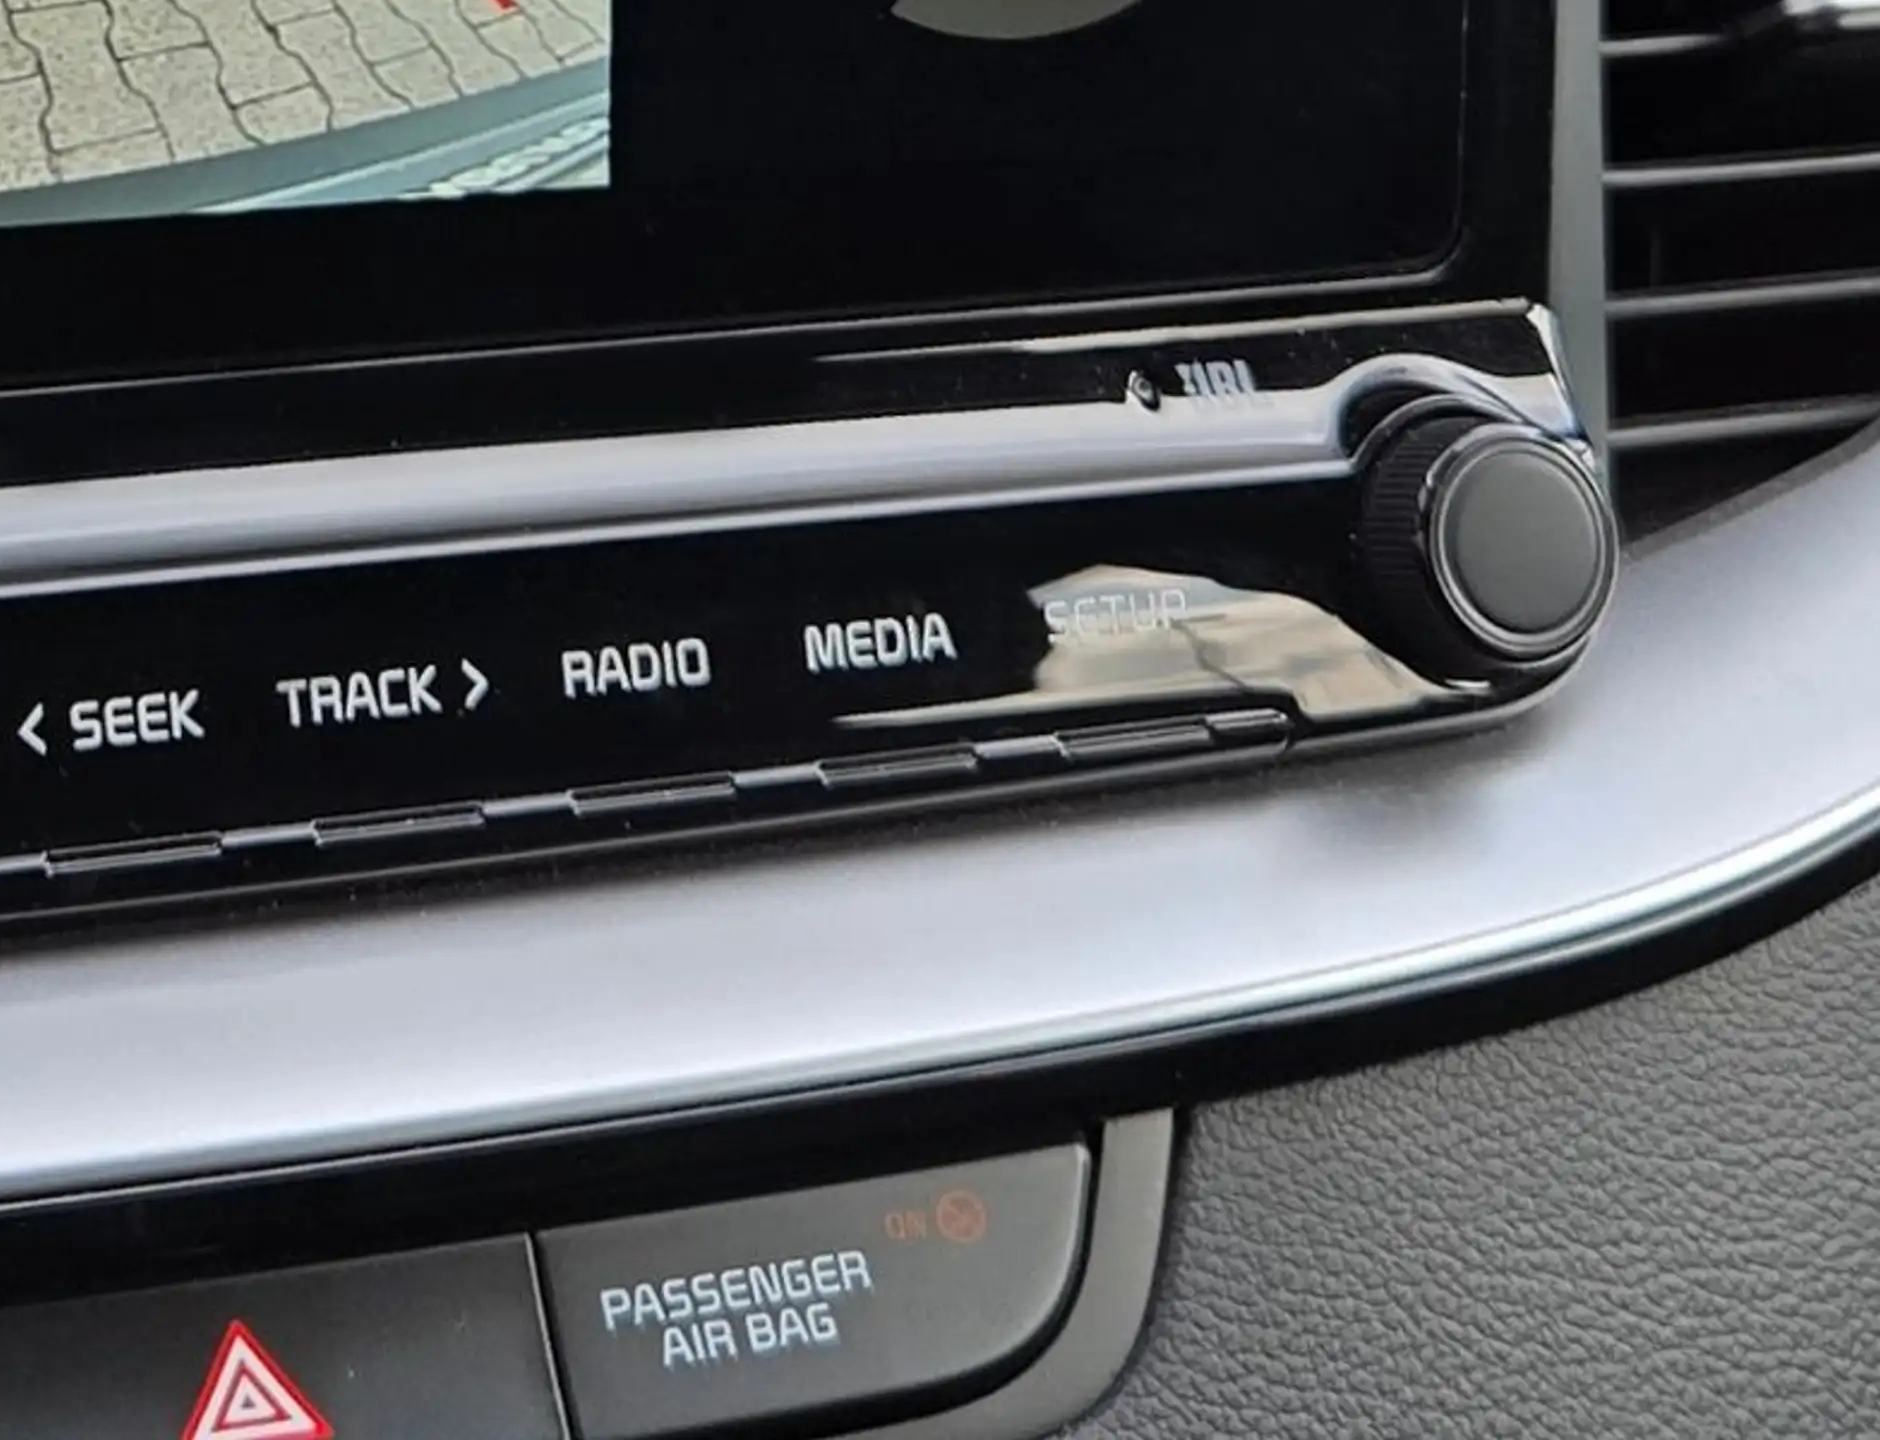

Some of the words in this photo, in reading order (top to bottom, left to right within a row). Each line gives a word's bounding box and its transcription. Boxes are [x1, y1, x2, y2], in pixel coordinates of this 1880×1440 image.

[561, 637, 712, 698] RADIO
[803, 612, 958, 675] MEDIA
[68, 689, 206, 752] SEEK
[276, 664, 442, 728] TRACK
[600, 1250, 872, 1331] PASSENGER
[660, 1320, 738, 1368] AIR
[747, 1303, 839, 1353] BAG
